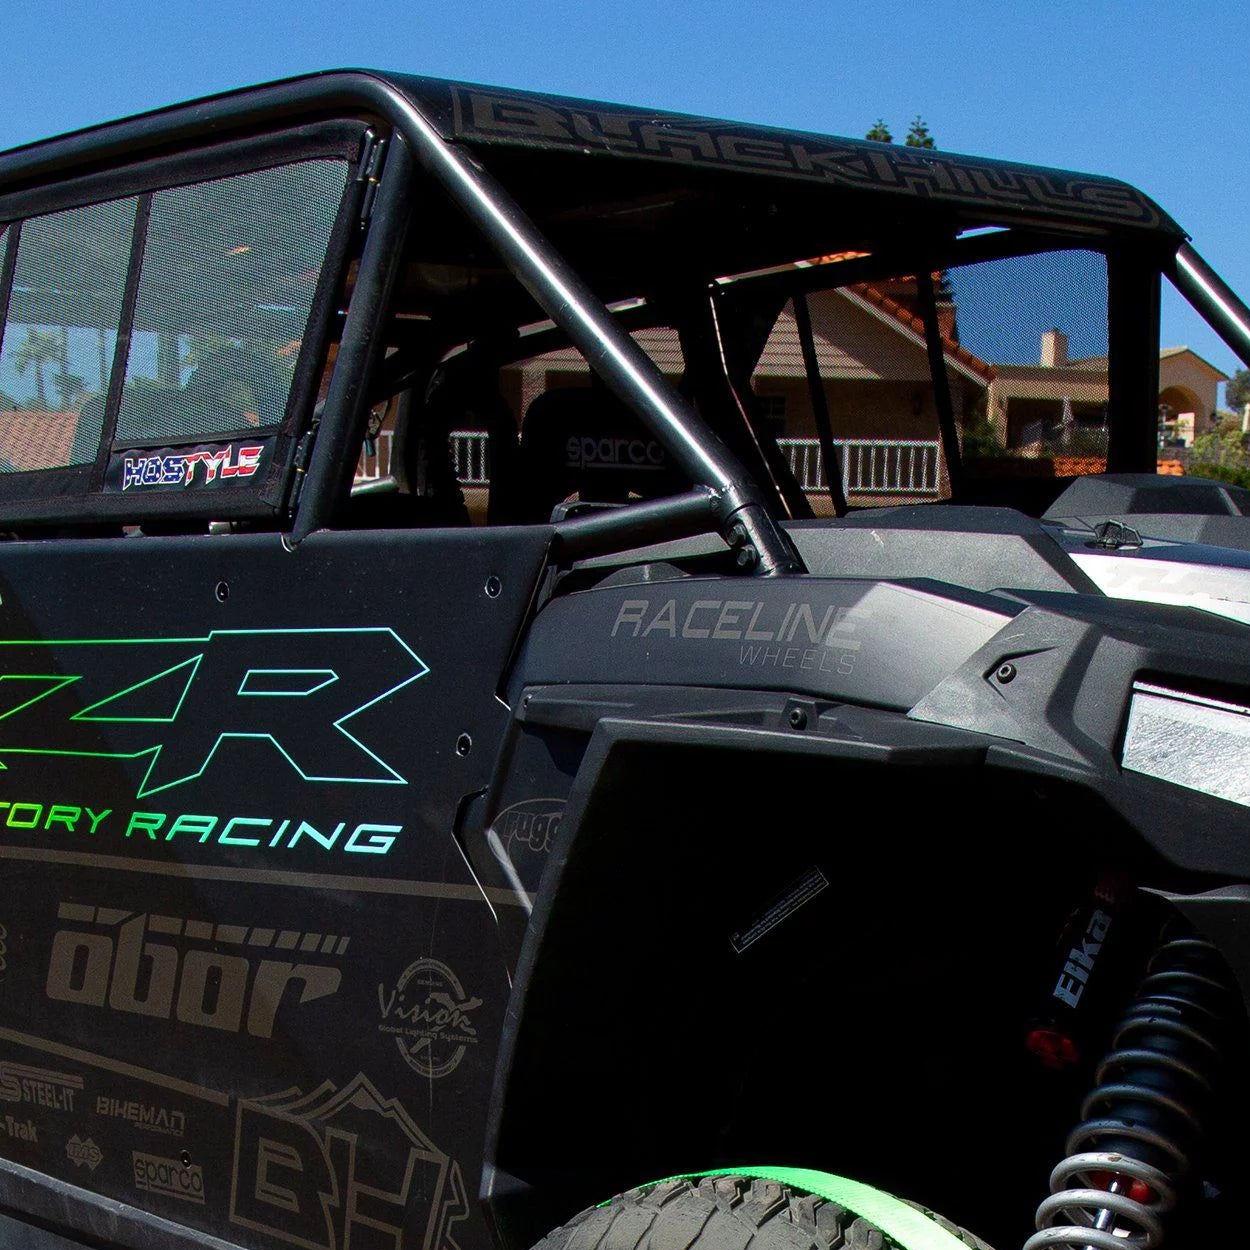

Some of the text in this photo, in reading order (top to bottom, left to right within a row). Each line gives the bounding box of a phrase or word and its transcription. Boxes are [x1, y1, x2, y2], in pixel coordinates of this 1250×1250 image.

[122, 444, 265, 491] HOSTYLE
[610, 599, 865, 651] RACELINE
[738, 645, 858, 676] WHEELS
[125, 812, 403, 855] RACING
[1052, 908, 1112, 1009] Elka
[135, 1157, 203, 1193] sparco
